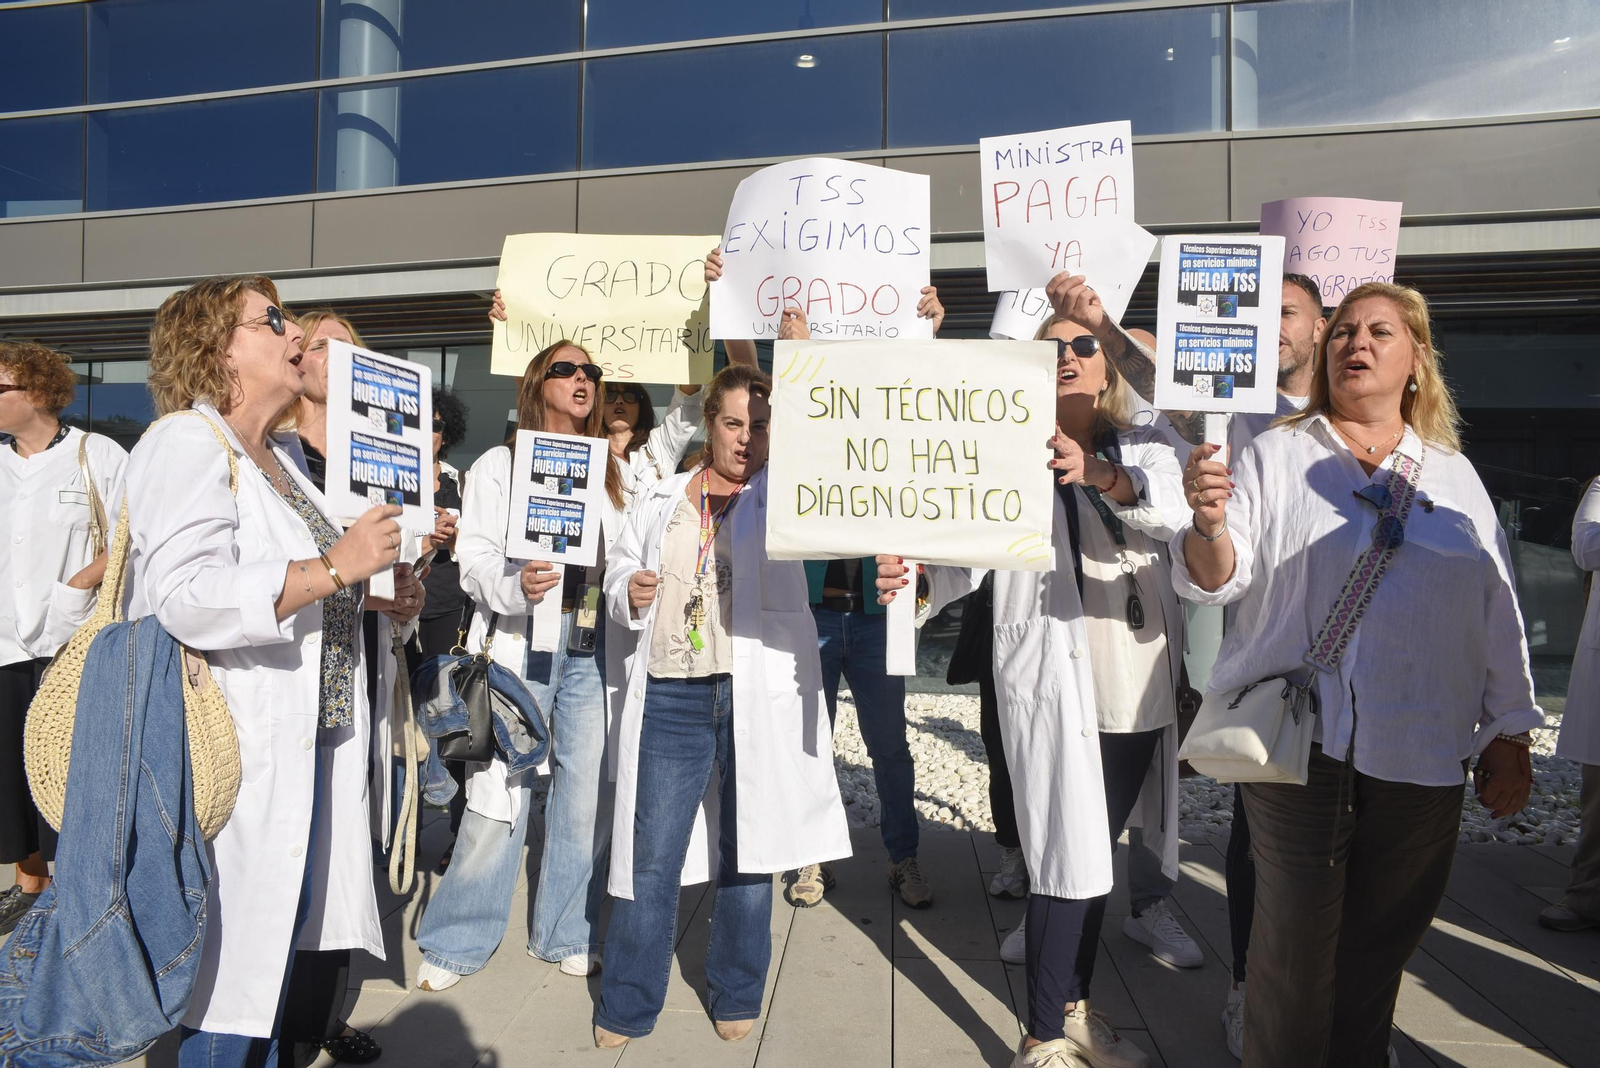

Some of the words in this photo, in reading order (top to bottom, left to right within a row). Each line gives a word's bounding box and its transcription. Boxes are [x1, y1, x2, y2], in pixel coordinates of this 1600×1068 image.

[995, 137, 1124, 171] MINISTRA
[788, 174, 867, 206] TSS
[993, 175, 1118, 228] PAGA
[1297, 209, 1333, 234] YO
[724, 211, 921, 256] EXIGIMOS
[1044, 239, 1083, 269] YA
[1183, 245, 1205, 253] Técnicos
[1205, 246, 1232, 255] Superiores
[1233, 247, 1257, 256] Sanitarios
[1289, 244, 1340, 263] AGO
[1348, 246, 1393, 264] TUS
[1182, 259, 1191, 268] en
[1192, 258, 1225, 268] servicios
[1226, 257, 1257, 268] mínimos
[547, 255, 709, 301] GRADO
[1181, 271, 1229, 292] HUELGA
[1232, 272, 1256, 293] TSS
[756, 275, 900, 317] GRADO
[752, 319, 899, 338] UNRSITARIO
[1179, 324, 1201, 333] Técnicos
[1201, 325, 1228, 335] Superiores
[1229, 327, 1254, 336] Sanitarios
[1178, 339, 1187, 348] en
[1188, 337, 1221, 348] servicios
[1222, 337, 1253, 348] mínimos
[597, 362, 634, 378] SS
[1176, 351, 1225, 372] HUELGA
[1229, 352, 1253, 373] TSS
[354, 368, 363, 380] en
[363, 370, 392, 387] servicios
[353, 380, 396, 411] HUELGA
[397, 391, 419, 417] TSS
[807, 379, 860, 420] SIN
[875, 378, 1031, 424] TÉCNICOS
[352, 447, 362, 459] en
[361, 449, 391, 464] servicios
[543, 449, 565, 458] servicios
[846, 437, 889, 472] NO
[911, 439, 980, 475] HAY
[352, 459, 396, 489] HUELGA
[397, 468, 418, 494] TSS
[533, 459, 567, 476] HUELGA
[570, 462, 587, 479] TSS
[796, 477, 1022, 522] DIAGNÓSTICO
[537, 508, 560, 516] servicios
[528, 516, 561, 534] HUELGA
[564, 520, 581, 537] TSS
